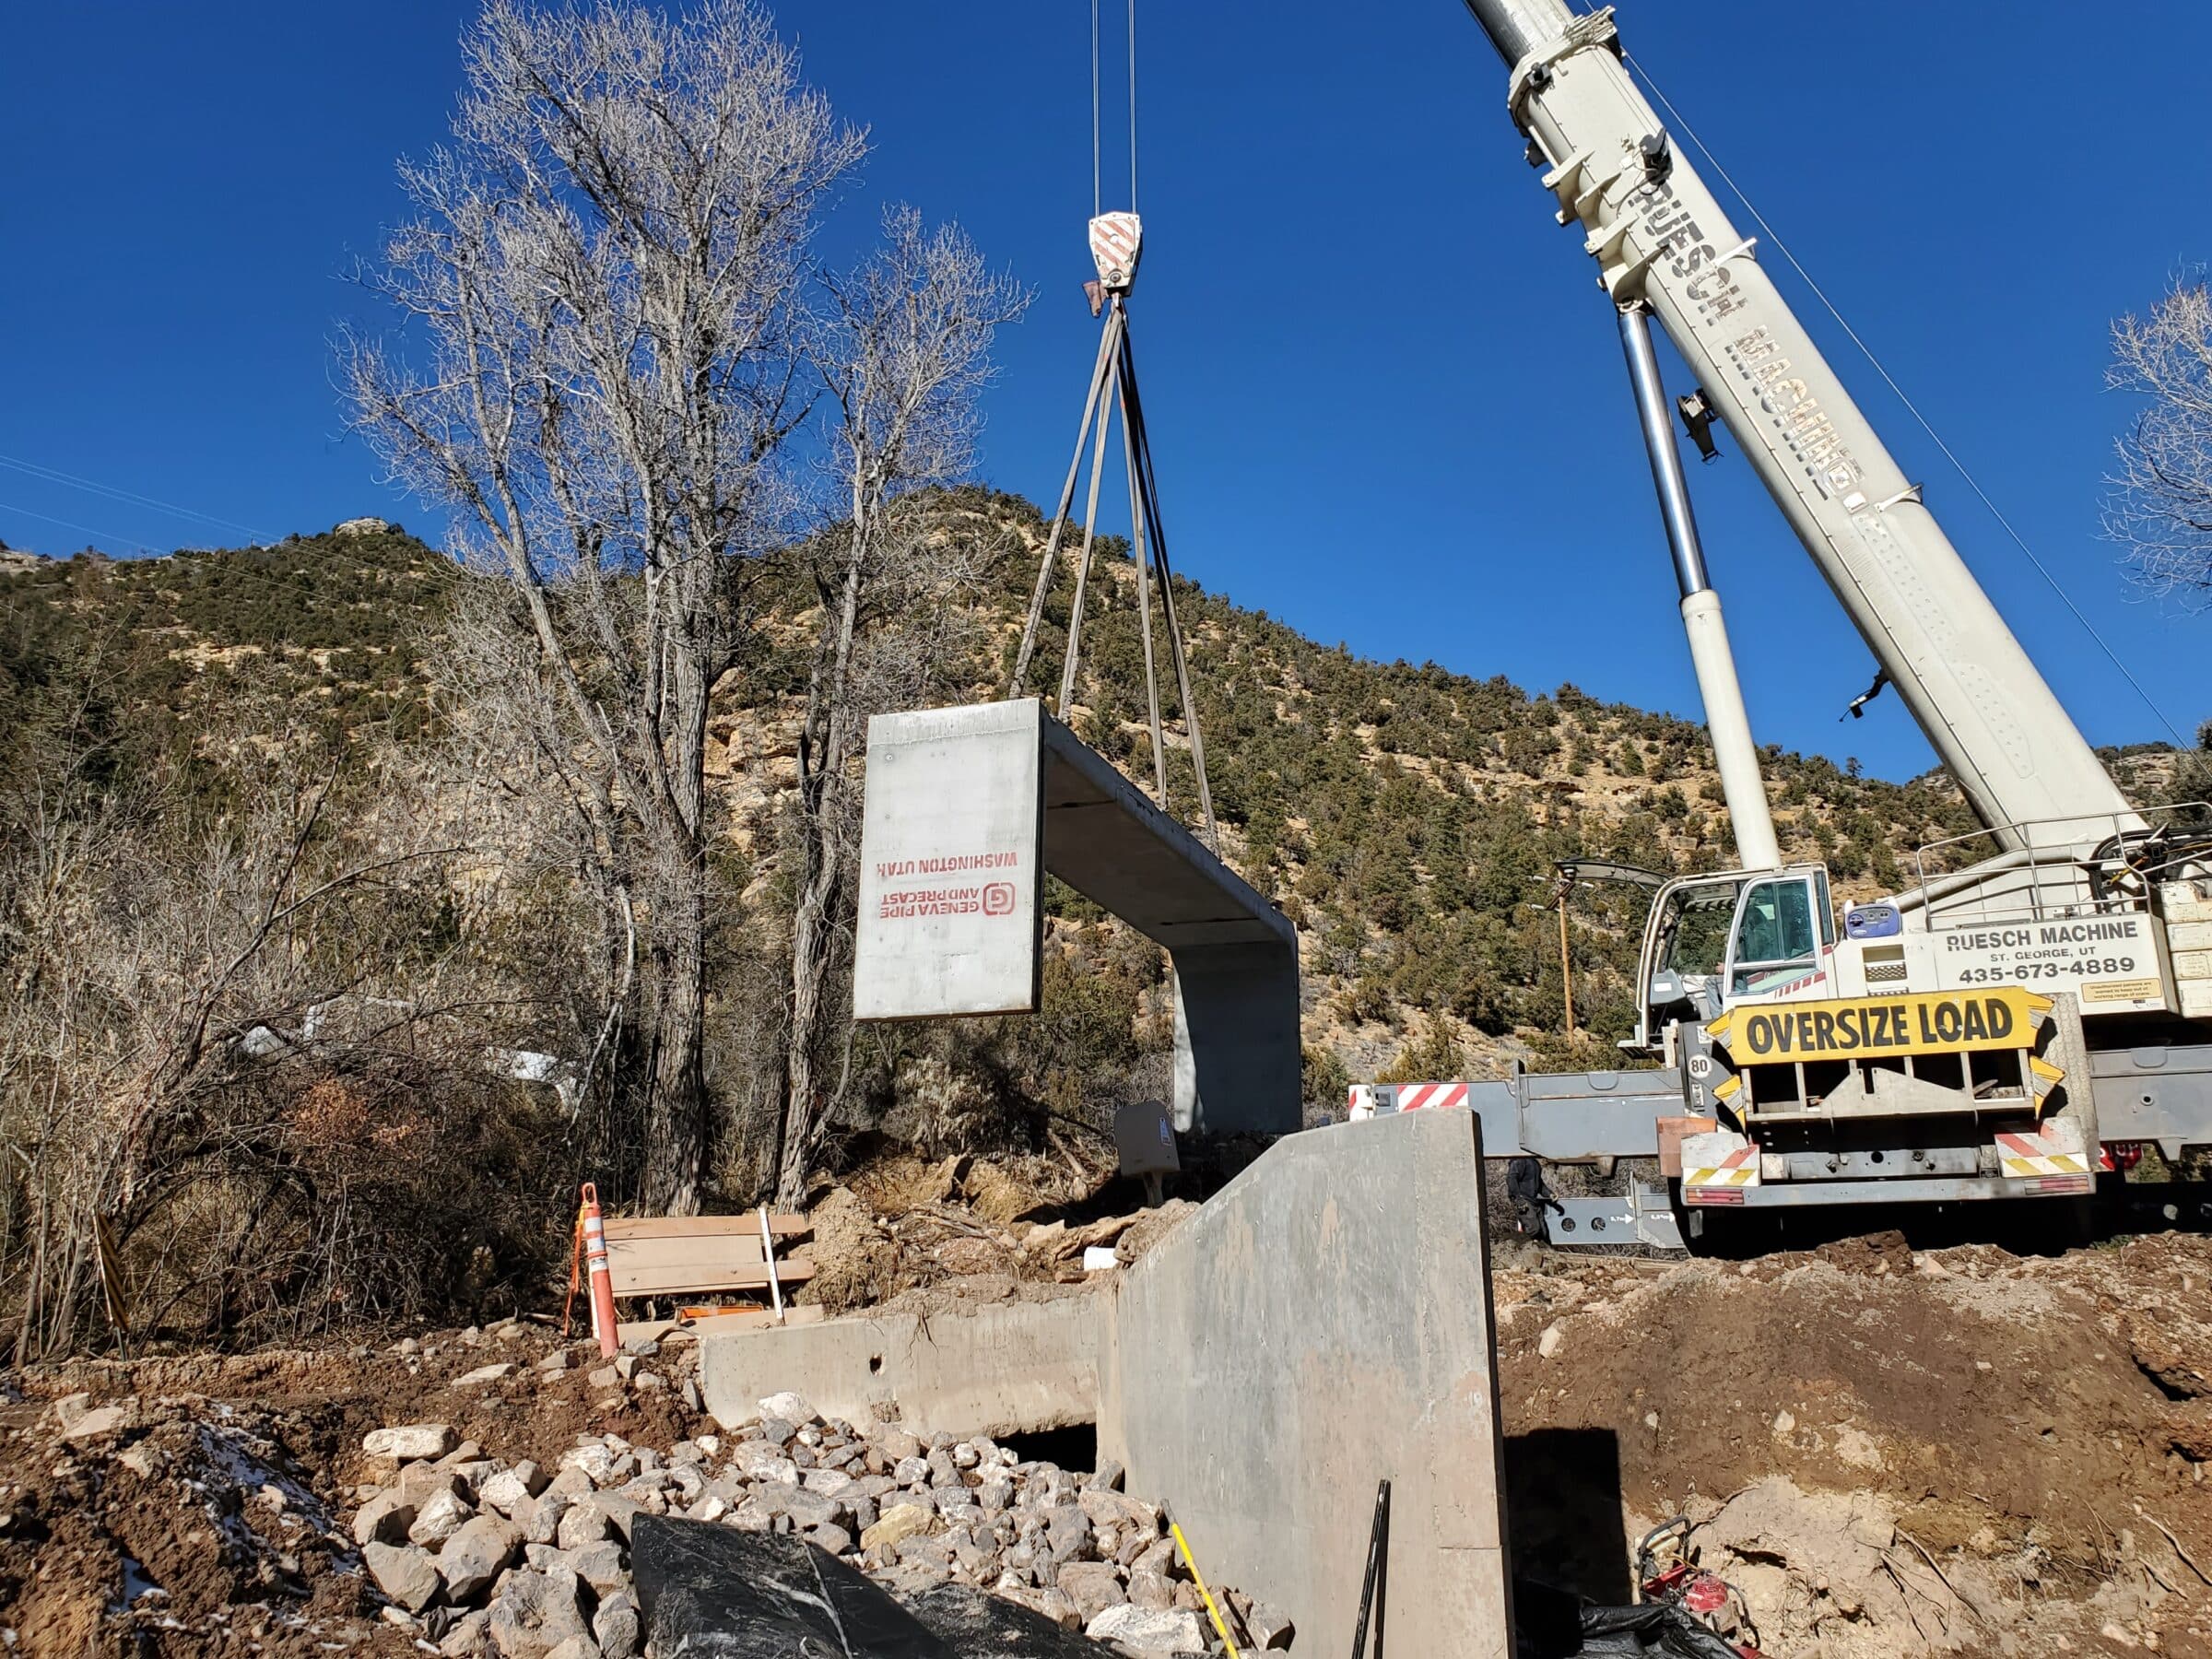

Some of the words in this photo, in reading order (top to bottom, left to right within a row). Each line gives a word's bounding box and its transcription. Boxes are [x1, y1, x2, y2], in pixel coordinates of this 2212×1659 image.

[1628, 182, 1747, 327] RUESCH
[877, 860, 915, 877] UTAH
[918, 852, 1018, 874] WASHINGTON
[880, 889, 947, 906] PRECAST
[947, 888, 979, 900] AND
[879, 904, 915, 919] PIPE
[918, 900, 980, 916] GENEVA
[1946, 930, 2031, 952] RUESCH
[2041, 921, 2138, 944] MACHINE
[1990, 953, 2010, 962] ST.
[2015, 948, 2074, 960] GEORGE,
[2079, 947, 2097, 956] UT
[1959, 957, 2136, 983] 435-673-4889
[1746, 1005, 1911, 1054] OVERSIZE
[1917, 998, 2013, 1044] LOAD
[1690, 1059, 1709, 1073] 80
